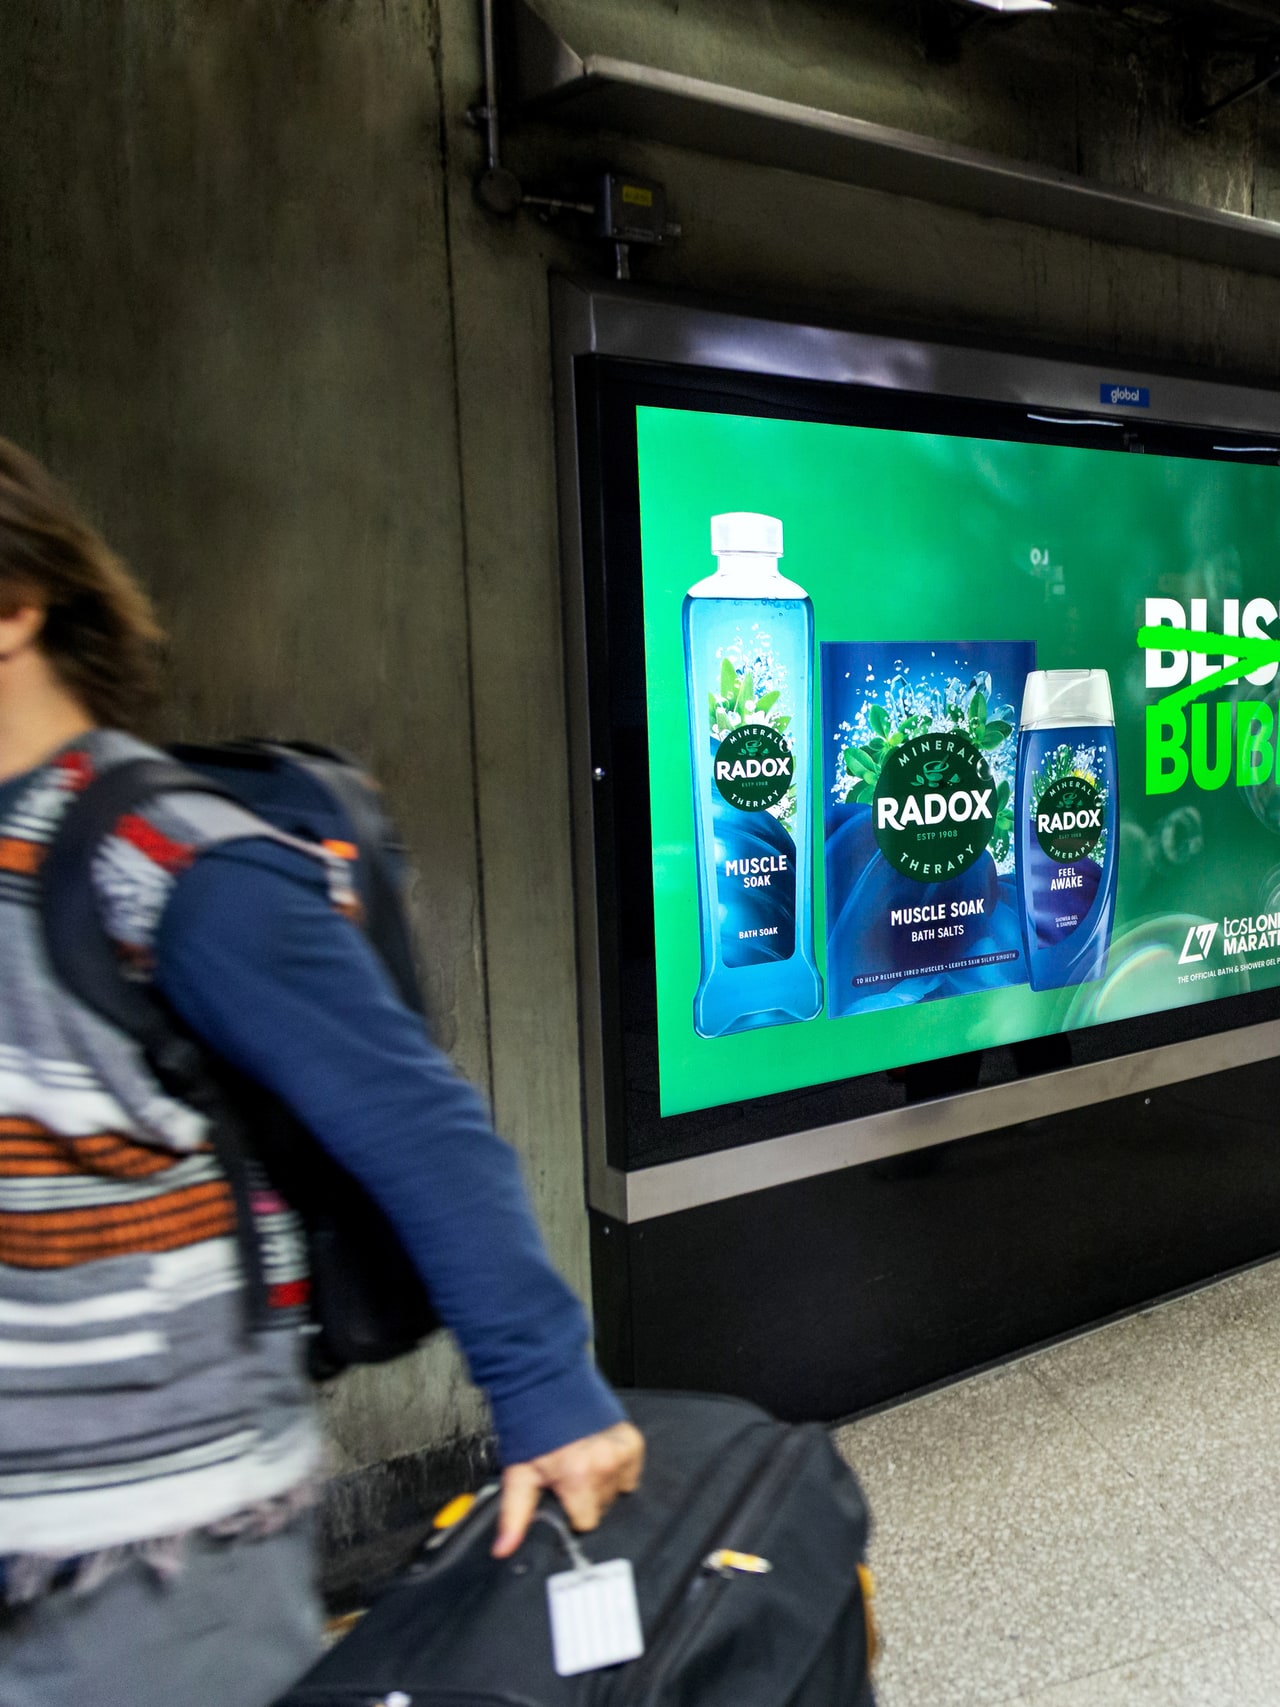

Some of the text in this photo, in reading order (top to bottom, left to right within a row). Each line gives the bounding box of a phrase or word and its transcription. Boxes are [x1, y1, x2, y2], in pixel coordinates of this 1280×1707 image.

[1110, 386, 1140, 404] global
[729, 728, 779, 745] MINERAL
[898, 740, 975, 767] MINERAL
[716, 757, 791, 781] RADOX
[1049, 780, 1092, 797] MINERAL
[731, 789, 779, 808] THERAPY
[877, 788, 993, 831] RADOX
[1037, 808, 1101, 834] RADOX
[939, 829, 958, 839] 1908
[899, 843, 974, 875] THERAPY
[1049, 841, 1091, 859] THERAPY
[725, 854, 788, 877] MUSCLE
[1058, 867, 1076, 877] FEEL
[743, 874, 771, 889] SOAK
[1050, 875, 1083, 891] AWAKE
[891, 898, 985, 927] MUSCLE SOAK
[738, 926, 779, 939] BATH SOAK
[911, 924, 965, 942] BATH SALTS
[864, 975, 880, 983] HELP
[880, 971, 902, 980] RELIEVE
[920, 964, 945, 974] MUSCLES
[1178, 975, 1189, 984] THE
[1189, 970, 1217, 982] OFFICIAL
[1217, 966, 1234, 976] BATH
[1234, 965, 1240, 973] &
[1240, 960, 1265, 972] SHOWER
[1265, 959, 1276, 967] GEL
